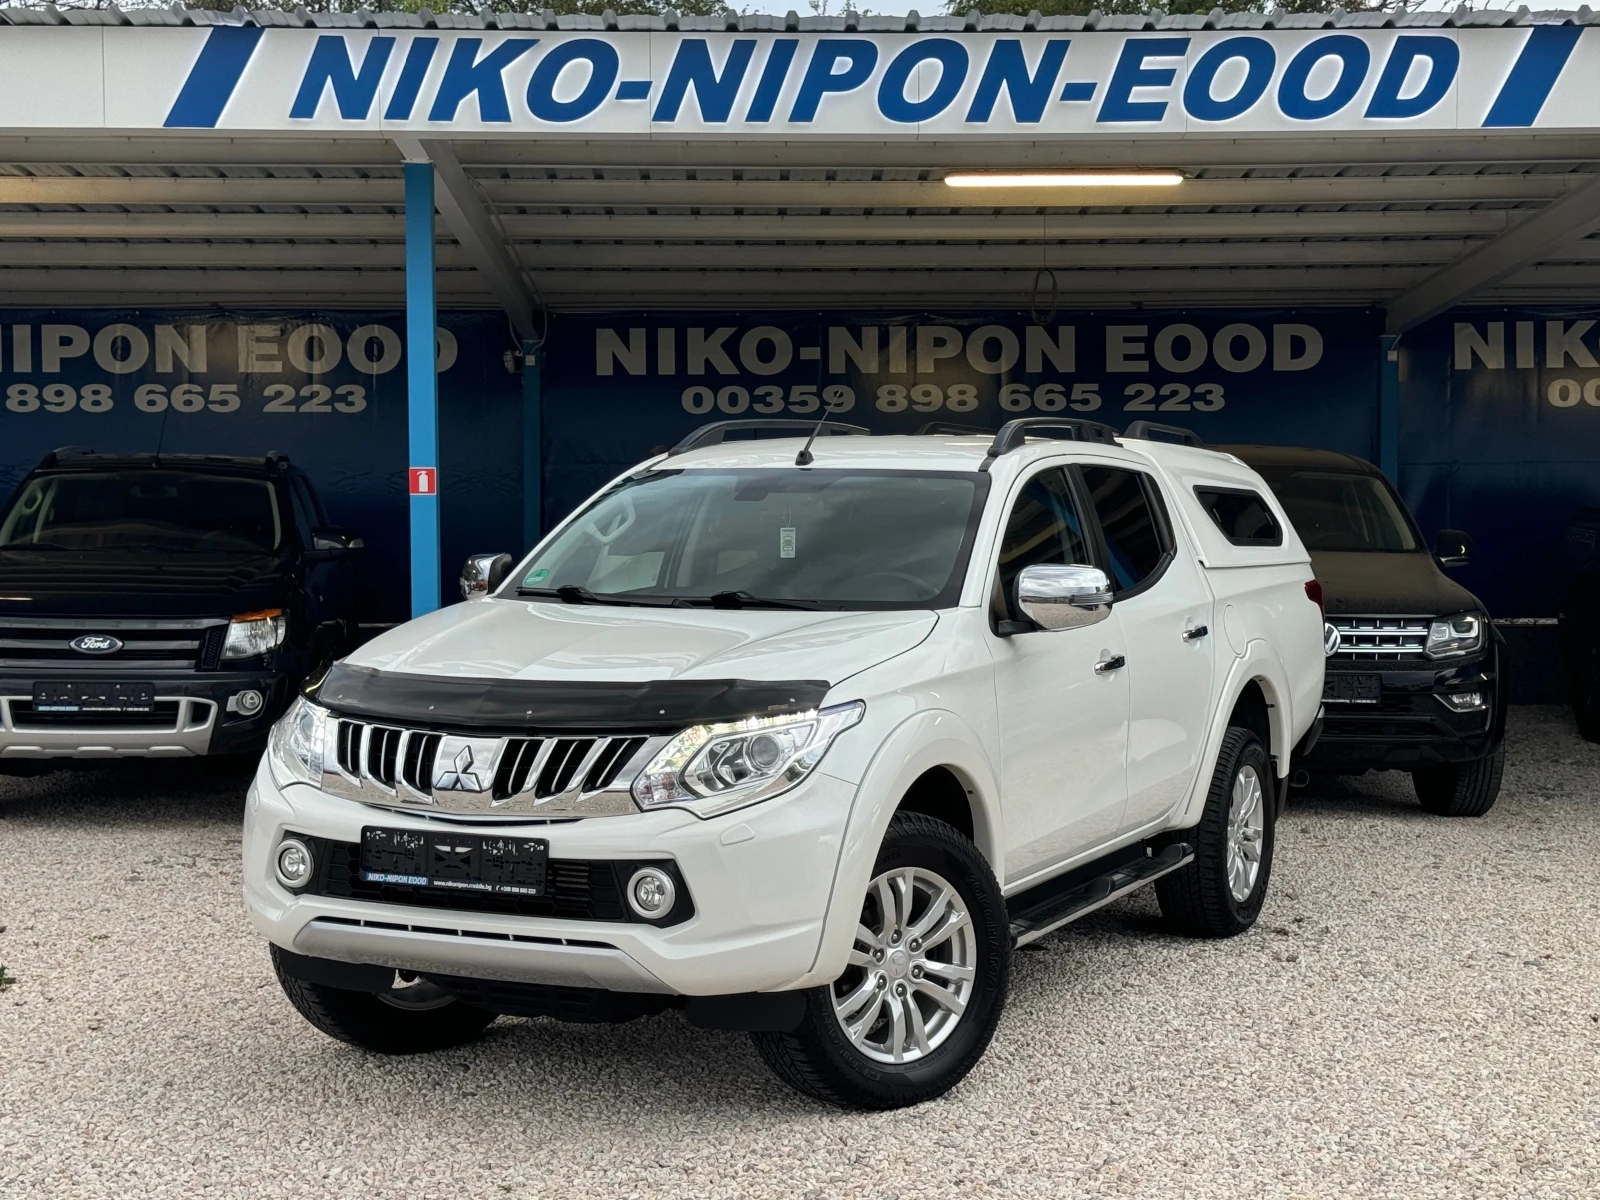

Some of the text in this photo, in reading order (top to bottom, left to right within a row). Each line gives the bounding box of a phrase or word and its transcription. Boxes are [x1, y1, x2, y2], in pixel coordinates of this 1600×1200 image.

[290, 35, 1460, 123] NIKO-NIPON-EOOD
[0, 322, 208, 376] IPON
[595, 322, 1324, 377] NIKO-NIPON EOOD
[1454, 320, 1600, 370] NIK
[5, 383, 367, 413] 898 665 223
[681, 383, 1226, 415] 00359 898 665 223
[81, 636, 111, 649] Ford
[367, 872, 427, 886] NIKO-NIPON EOOD
